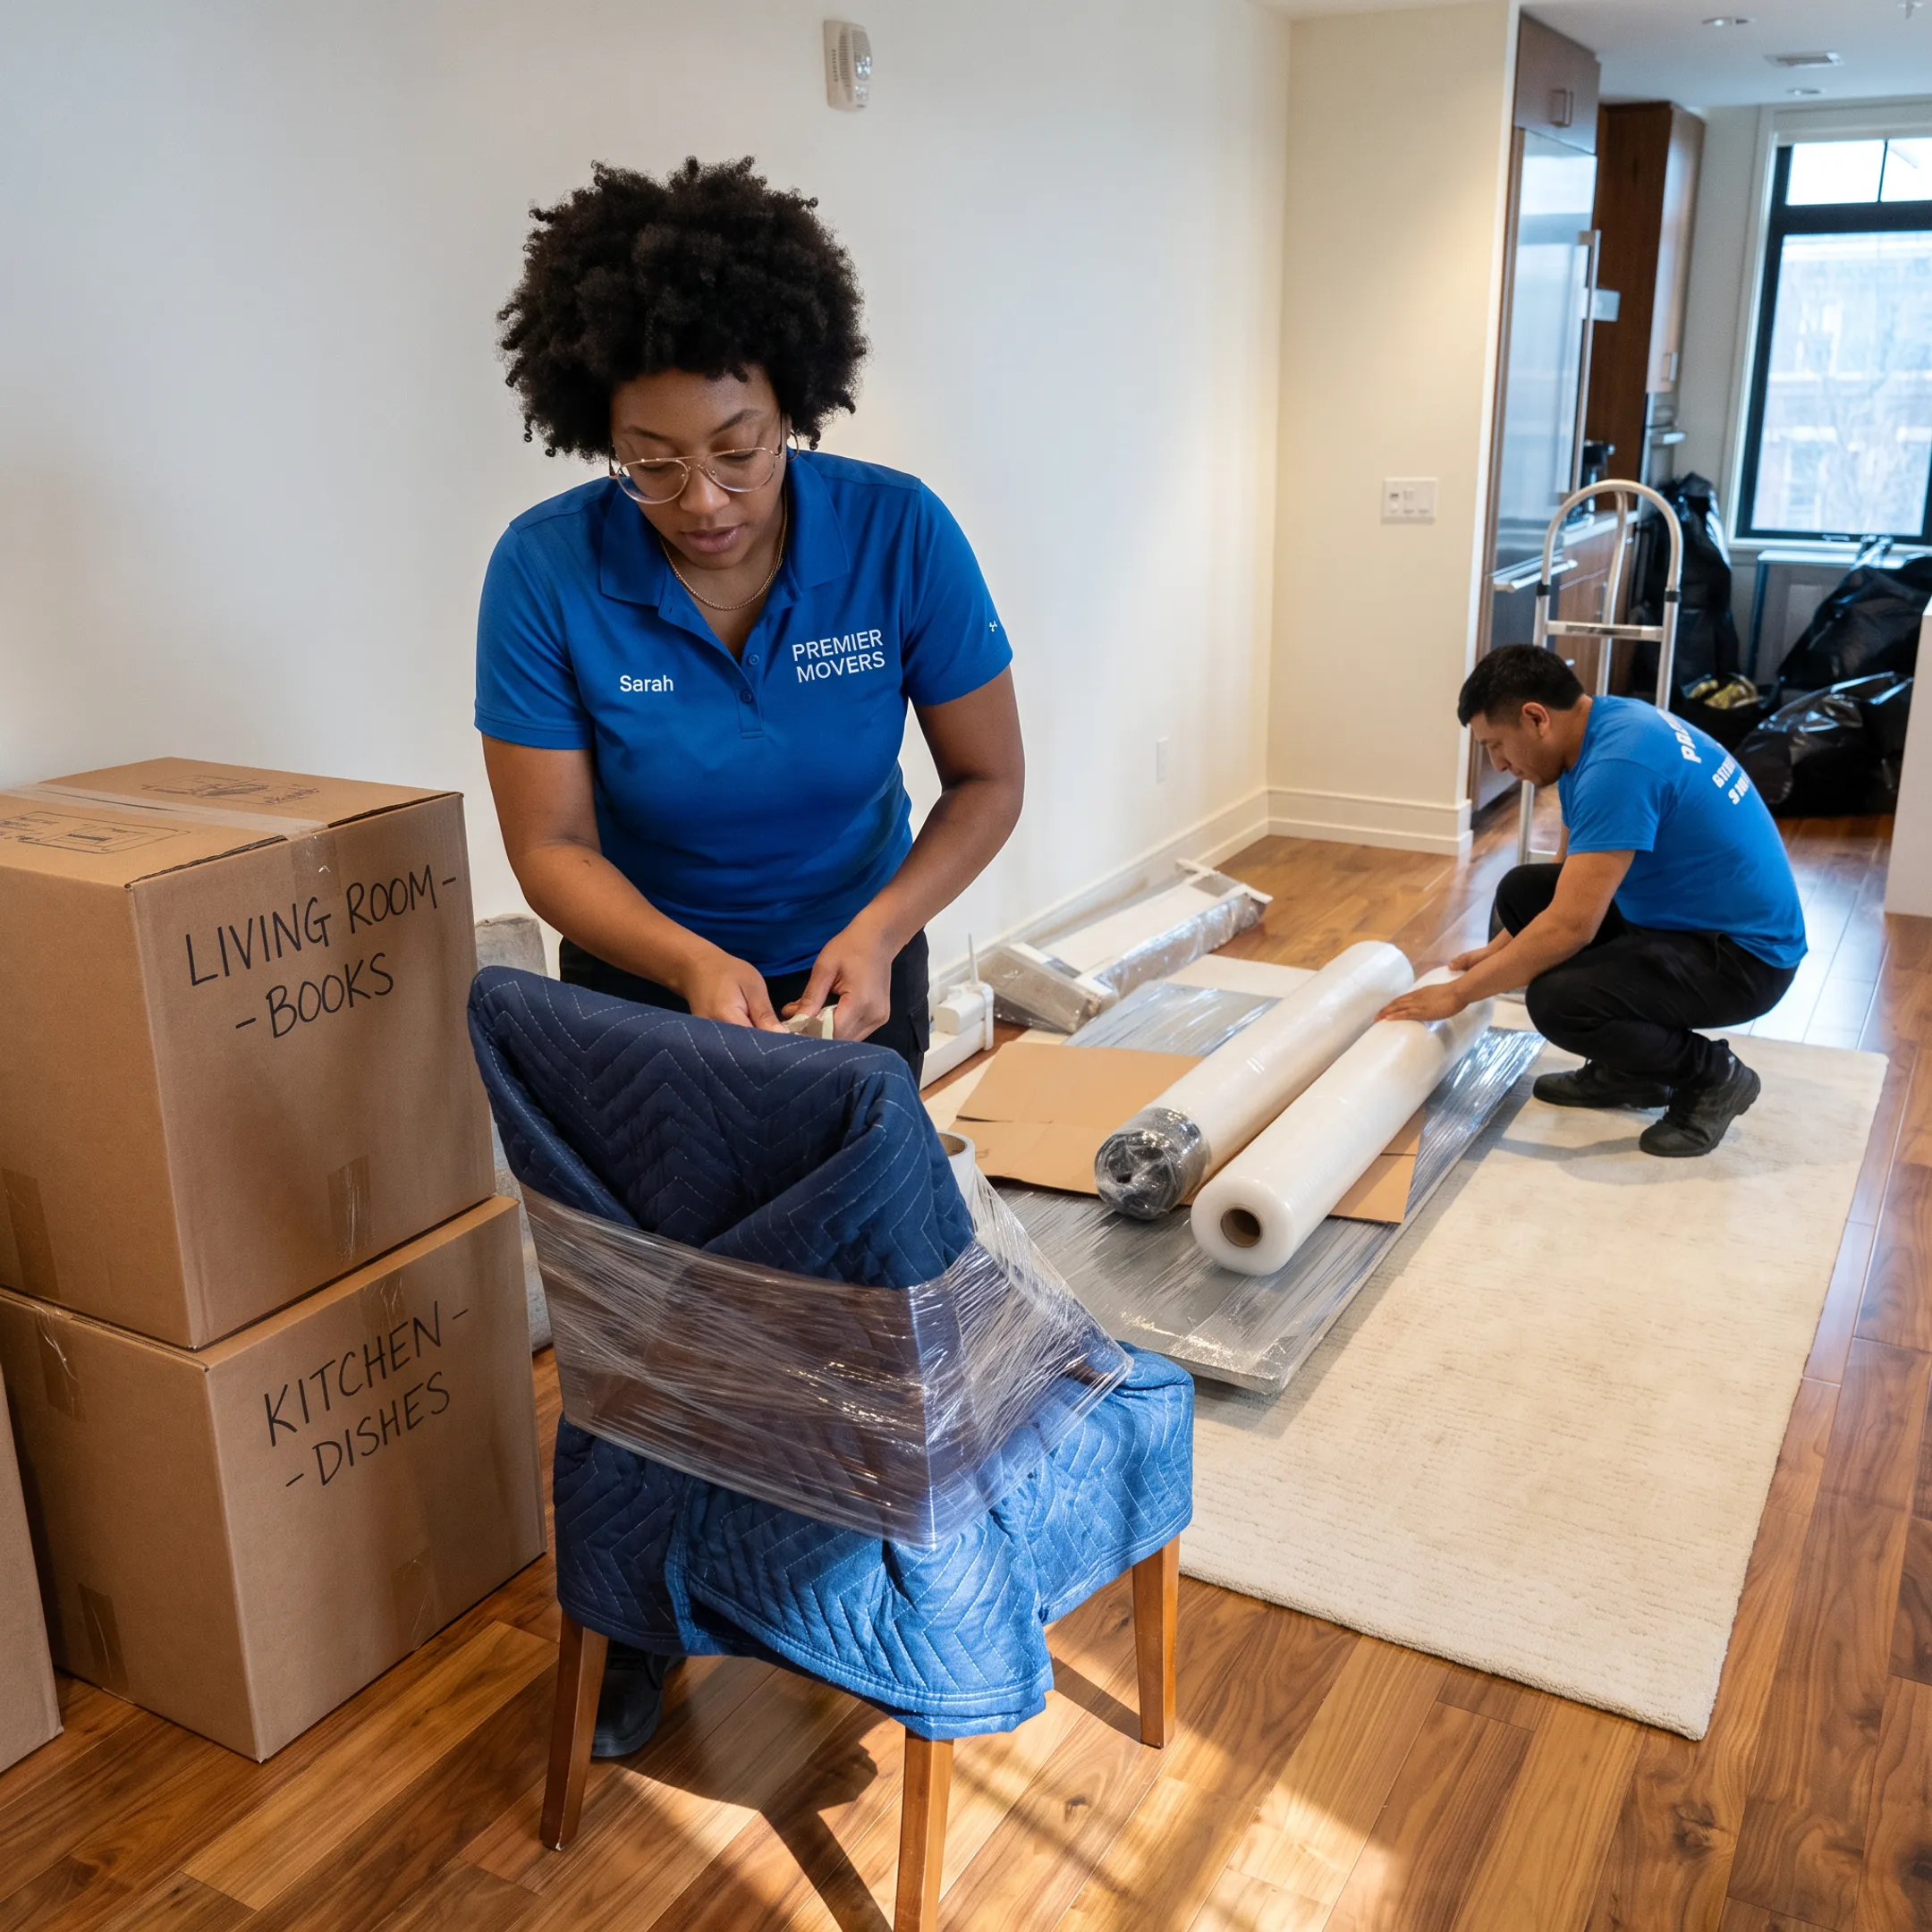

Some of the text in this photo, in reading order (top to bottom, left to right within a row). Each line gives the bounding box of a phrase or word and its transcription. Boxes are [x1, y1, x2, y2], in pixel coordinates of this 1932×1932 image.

[792, 629, 884, 662] PREMIER
[796, 650, 886, 683] MOVERS
[619, 674, 674, 693] Sarah
[185, 896, 332, 987] LIVING
